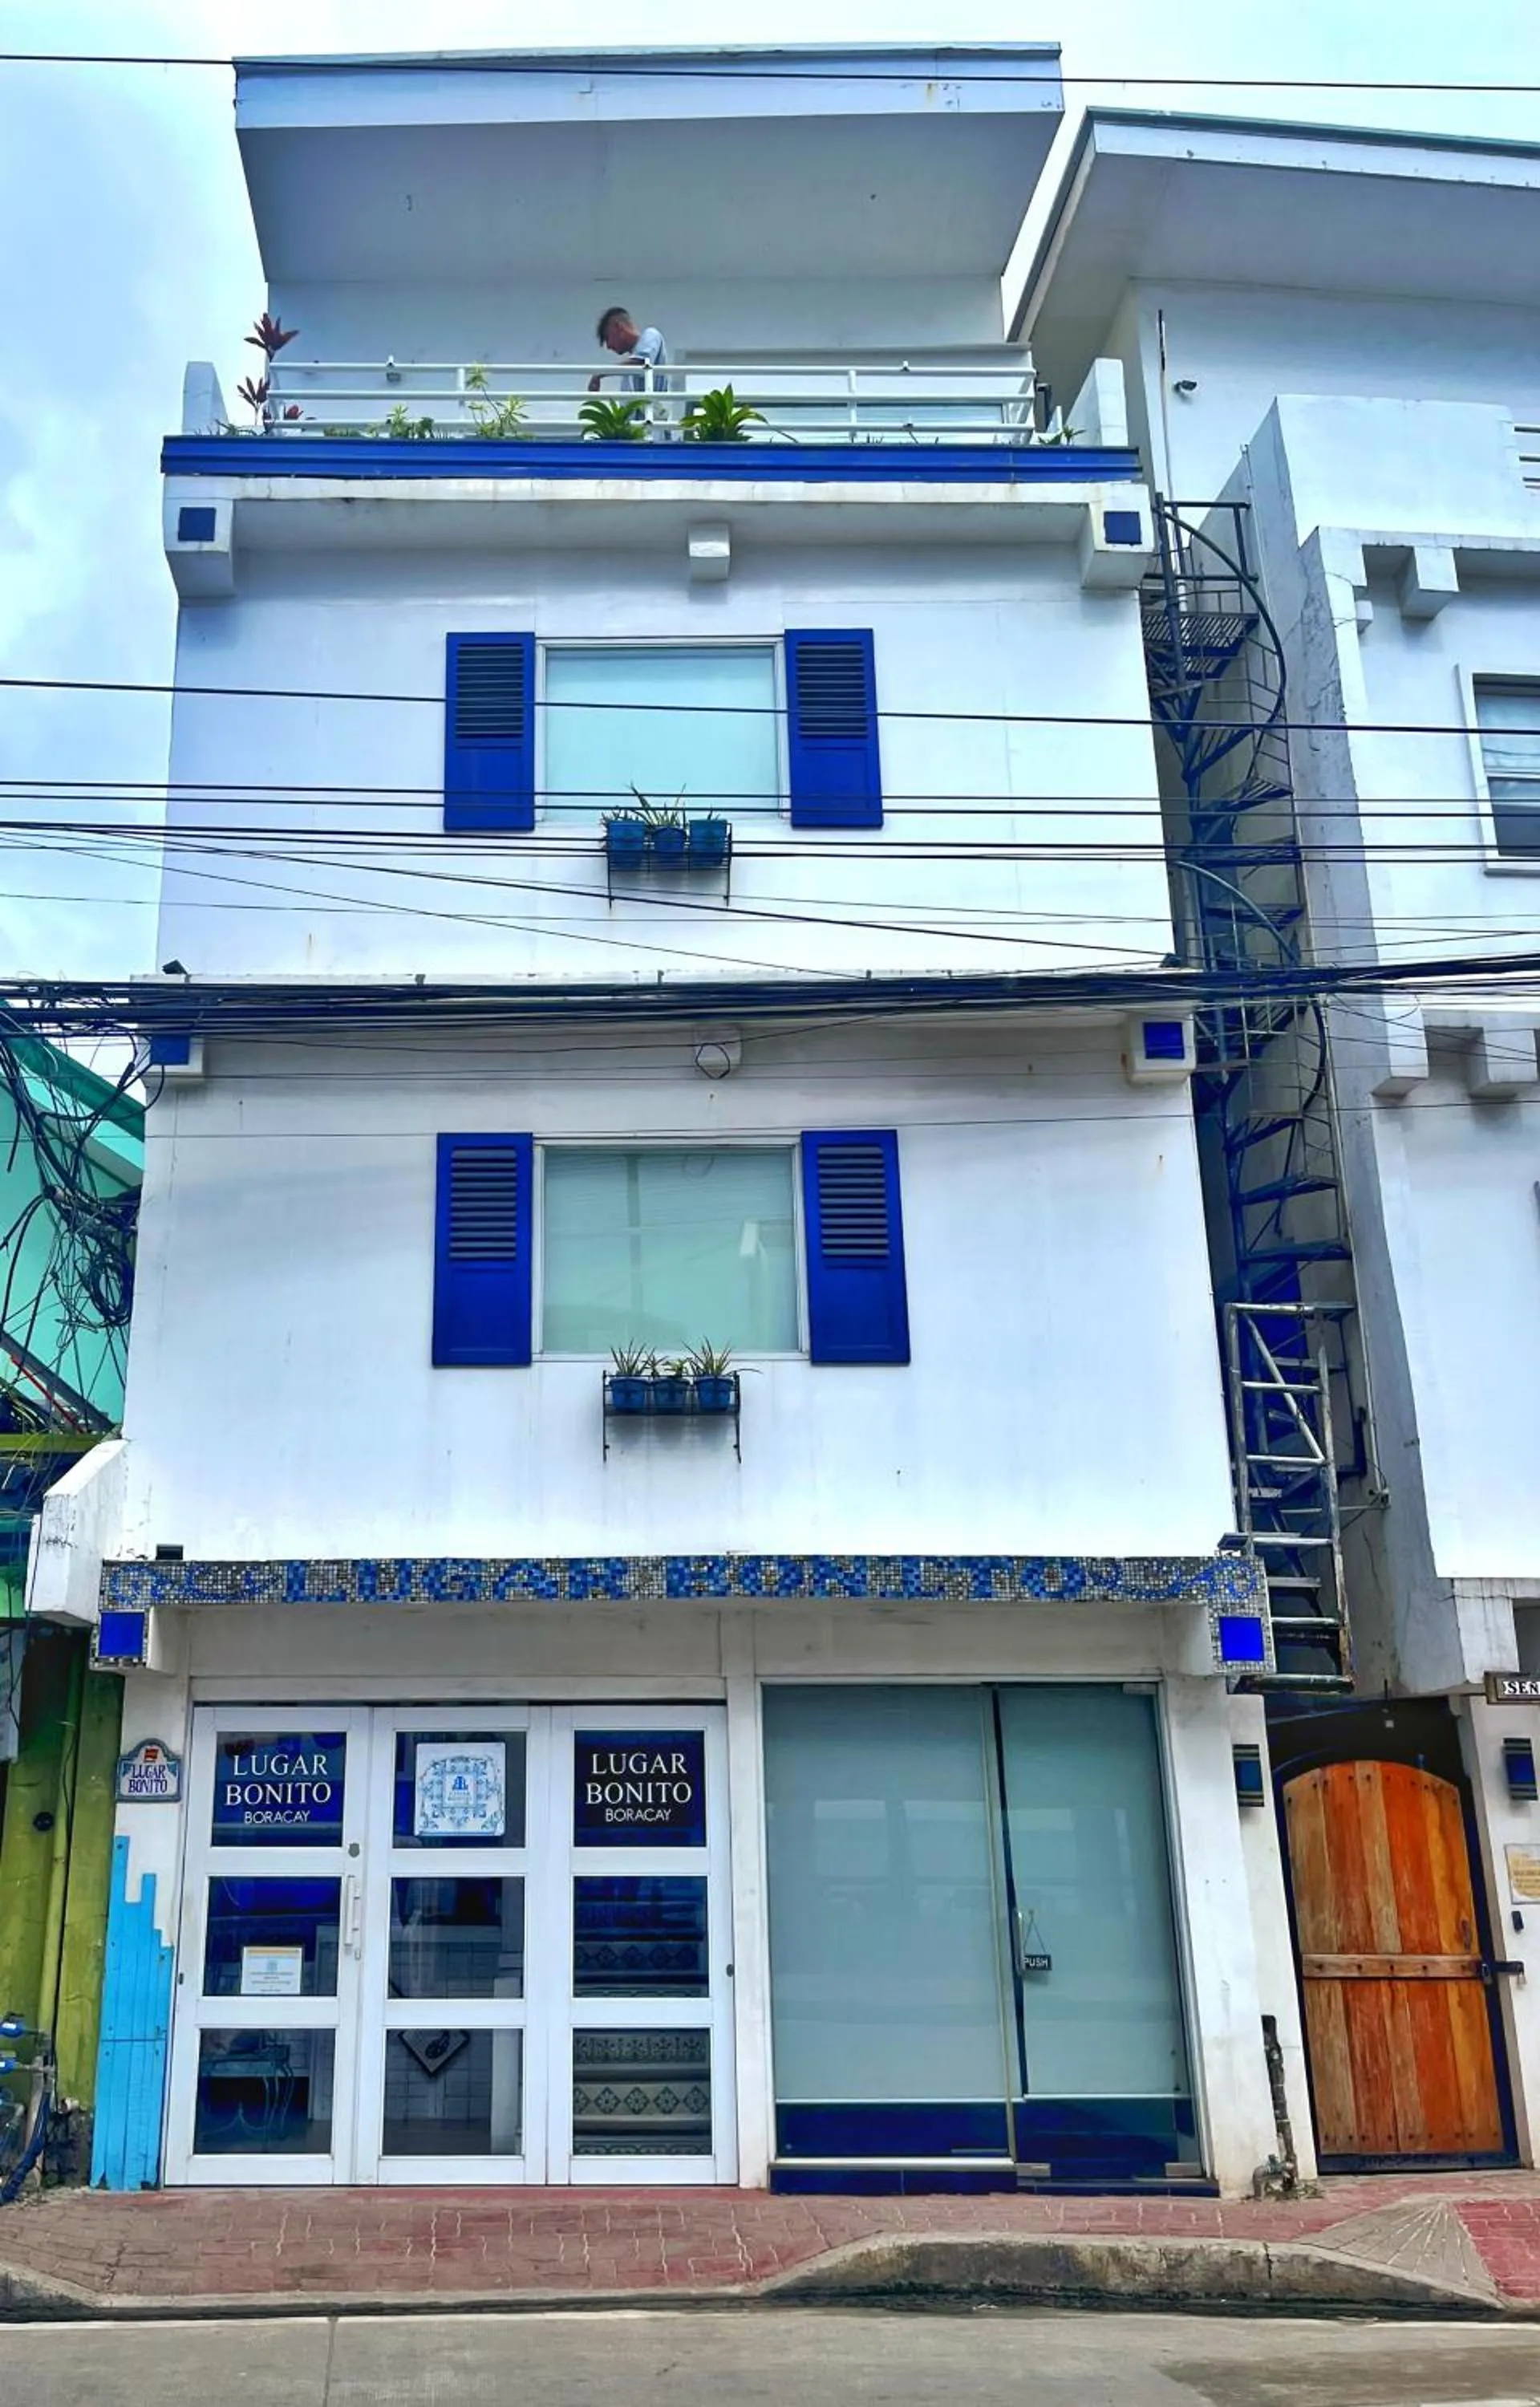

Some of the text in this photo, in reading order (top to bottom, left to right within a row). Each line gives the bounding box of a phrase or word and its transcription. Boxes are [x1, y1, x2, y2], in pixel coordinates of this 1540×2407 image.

[282, 1555, 1087, 1601] LUGAR BONITO
[132, 1764, 166, 1779] LUGAR
[233, 1754, 328, 1776] LUGAR
[592, 1752, 687, 1774] LUGAR
[128, 1779, 168, 1793] BONITO
[225, 1782, 331, 1806] BONITO
[586, 1782, 692, 1804] BONITO
[244, 1810, 310, 1824] BORACAY
[605, 1808, 671, 1822] BORACAY
[1023, 1957, 1048, 1967] PUSH
